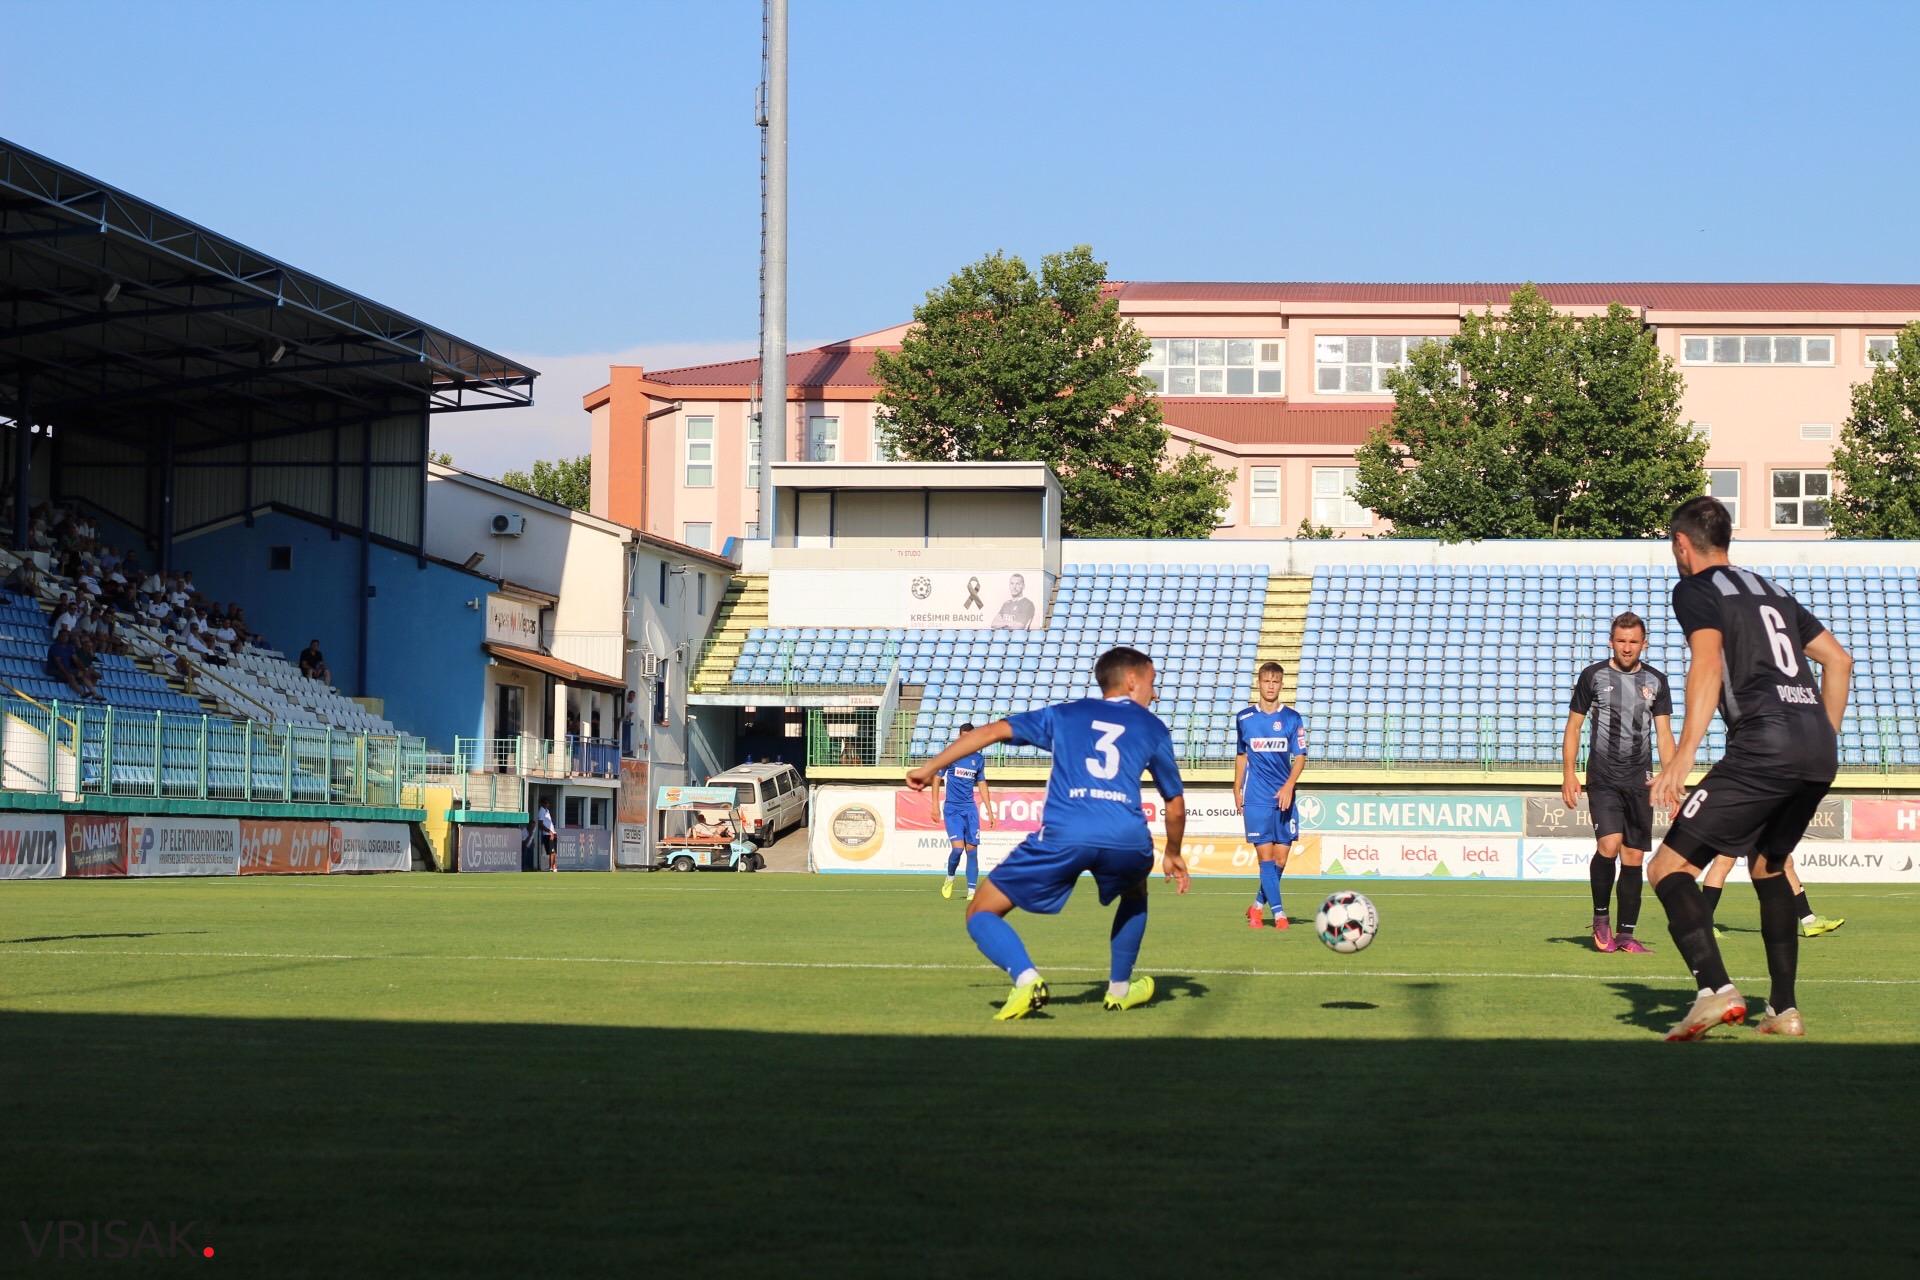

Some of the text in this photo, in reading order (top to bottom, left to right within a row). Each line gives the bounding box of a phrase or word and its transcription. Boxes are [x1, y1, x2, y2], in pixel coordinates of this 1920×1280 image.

[910, 613, 950, 622] KREŠIMIR
[1760, 605, 1799, 678] 6
[1085, 720, 1125, 780] 3
[1069, 788, 1087, 798] HT
[1683, 789, 1708, 818] 6
[1160, 808, 1203, 817] CRAL
[1336, 802, 1512, 827] SJEMENARNA
[1289, 818, 1296, 834] 6
[83, 822, 121, 851] NAMEX
[170, 829, 234, 852] ELEKTROPRIVREDA
[1343, 844, 1380, 861] leda
[1401, 845, 1438, 862] leda
[1462, 845, 1500, 862] leda
[1800, 854, 1884, 868] JABUKA.TV
